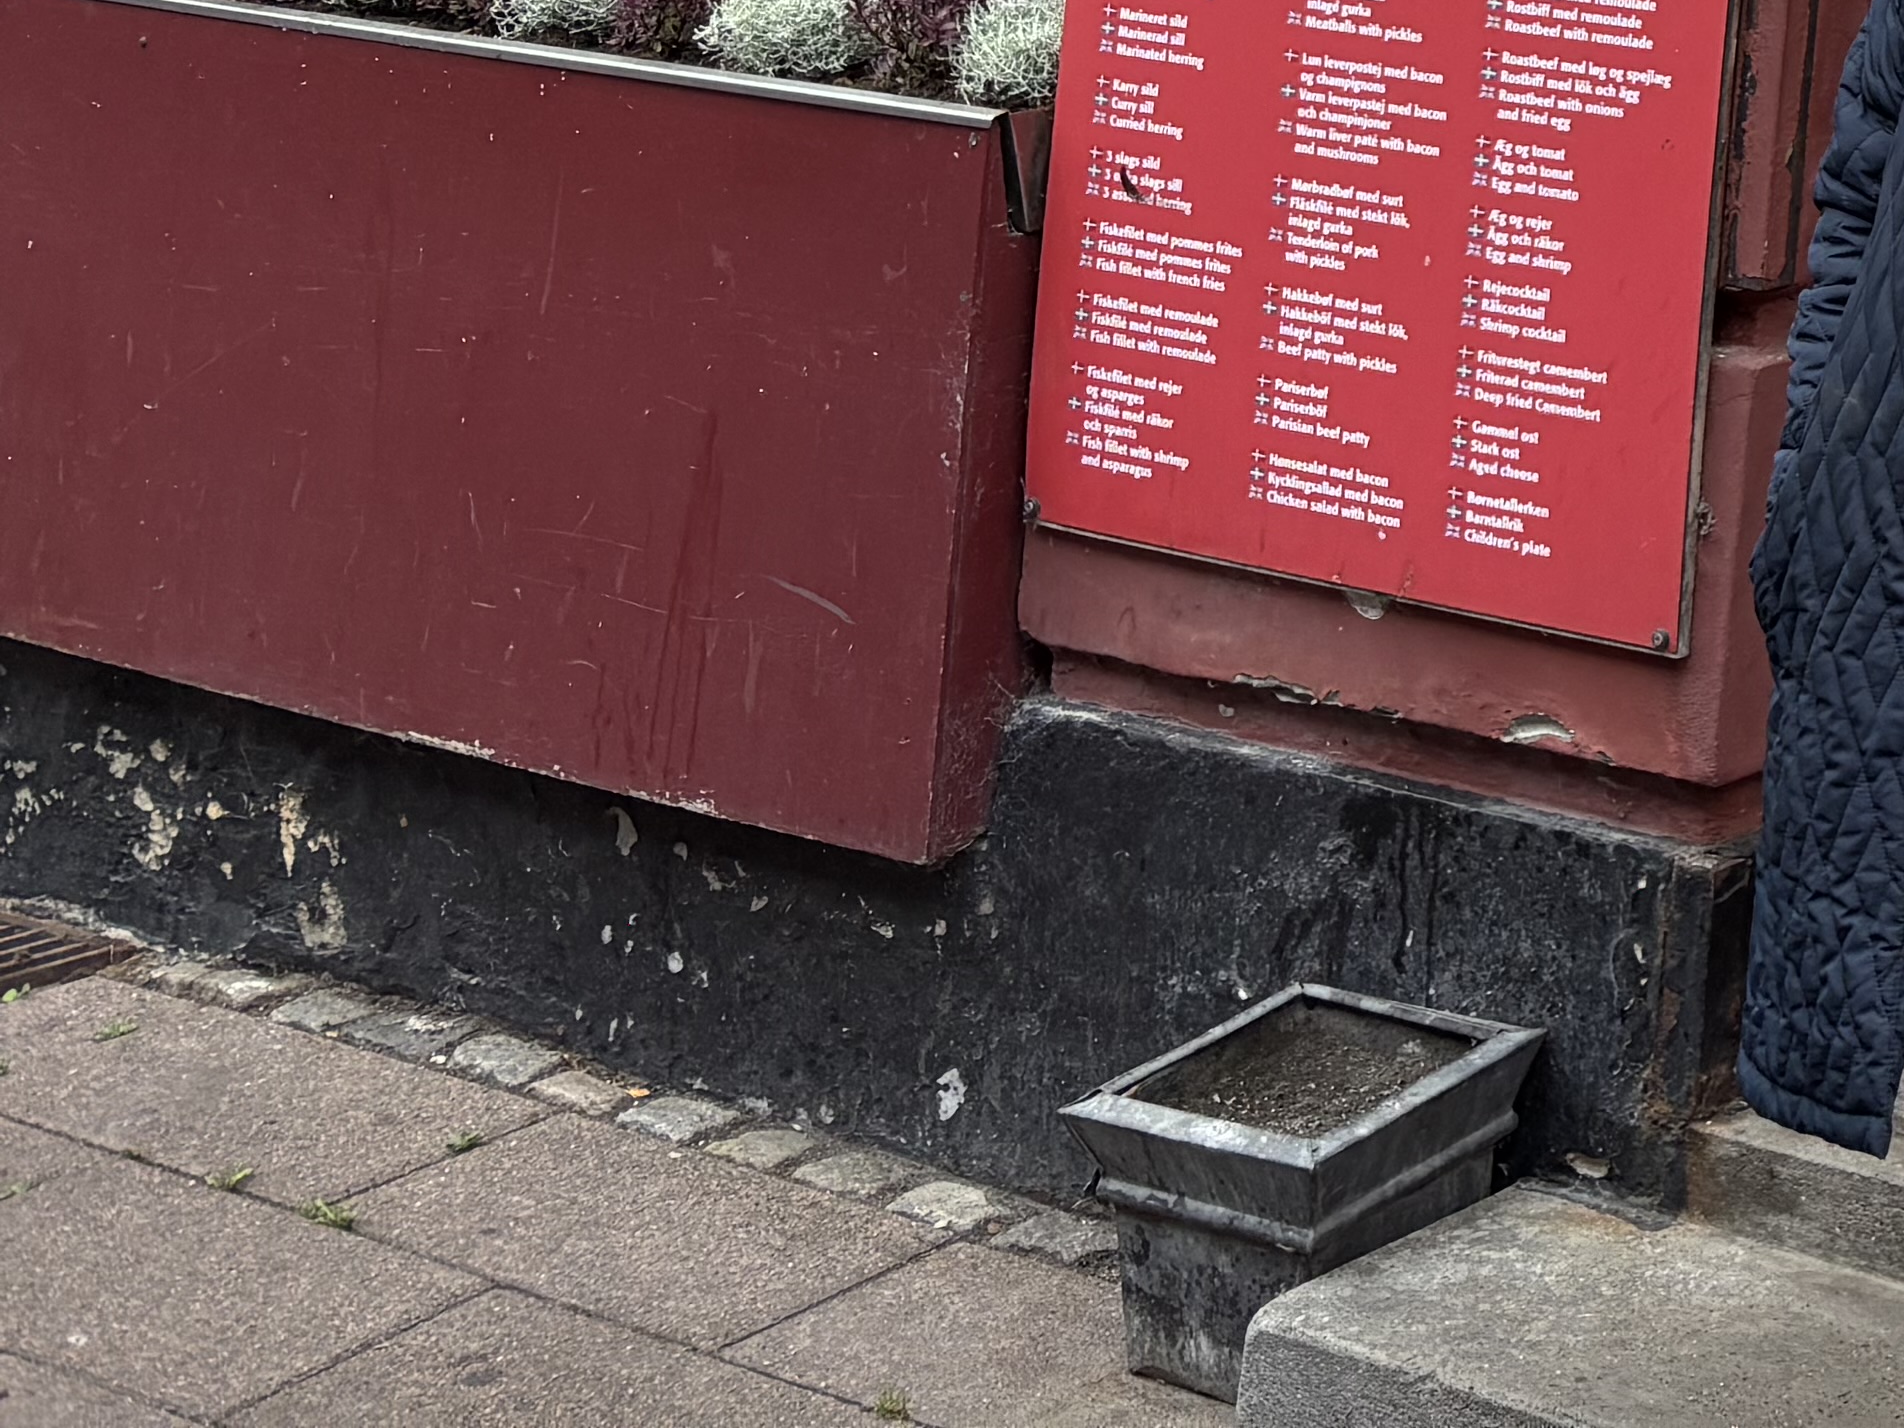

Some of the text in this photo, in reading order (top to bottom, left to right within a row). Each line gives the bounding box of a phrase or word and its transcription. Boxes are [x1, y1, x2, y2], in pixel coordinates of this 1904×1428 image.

[1305, 16, 1422, 42] Meatballs with pickles
[1168, 50, 1204, 70] herring
[1499, 89, 1624, 118] Roastbeef with onions
[1497, 108, 1571, 131] and fried egg
[1272, 416, 1370, 448] Parisian beef patty
